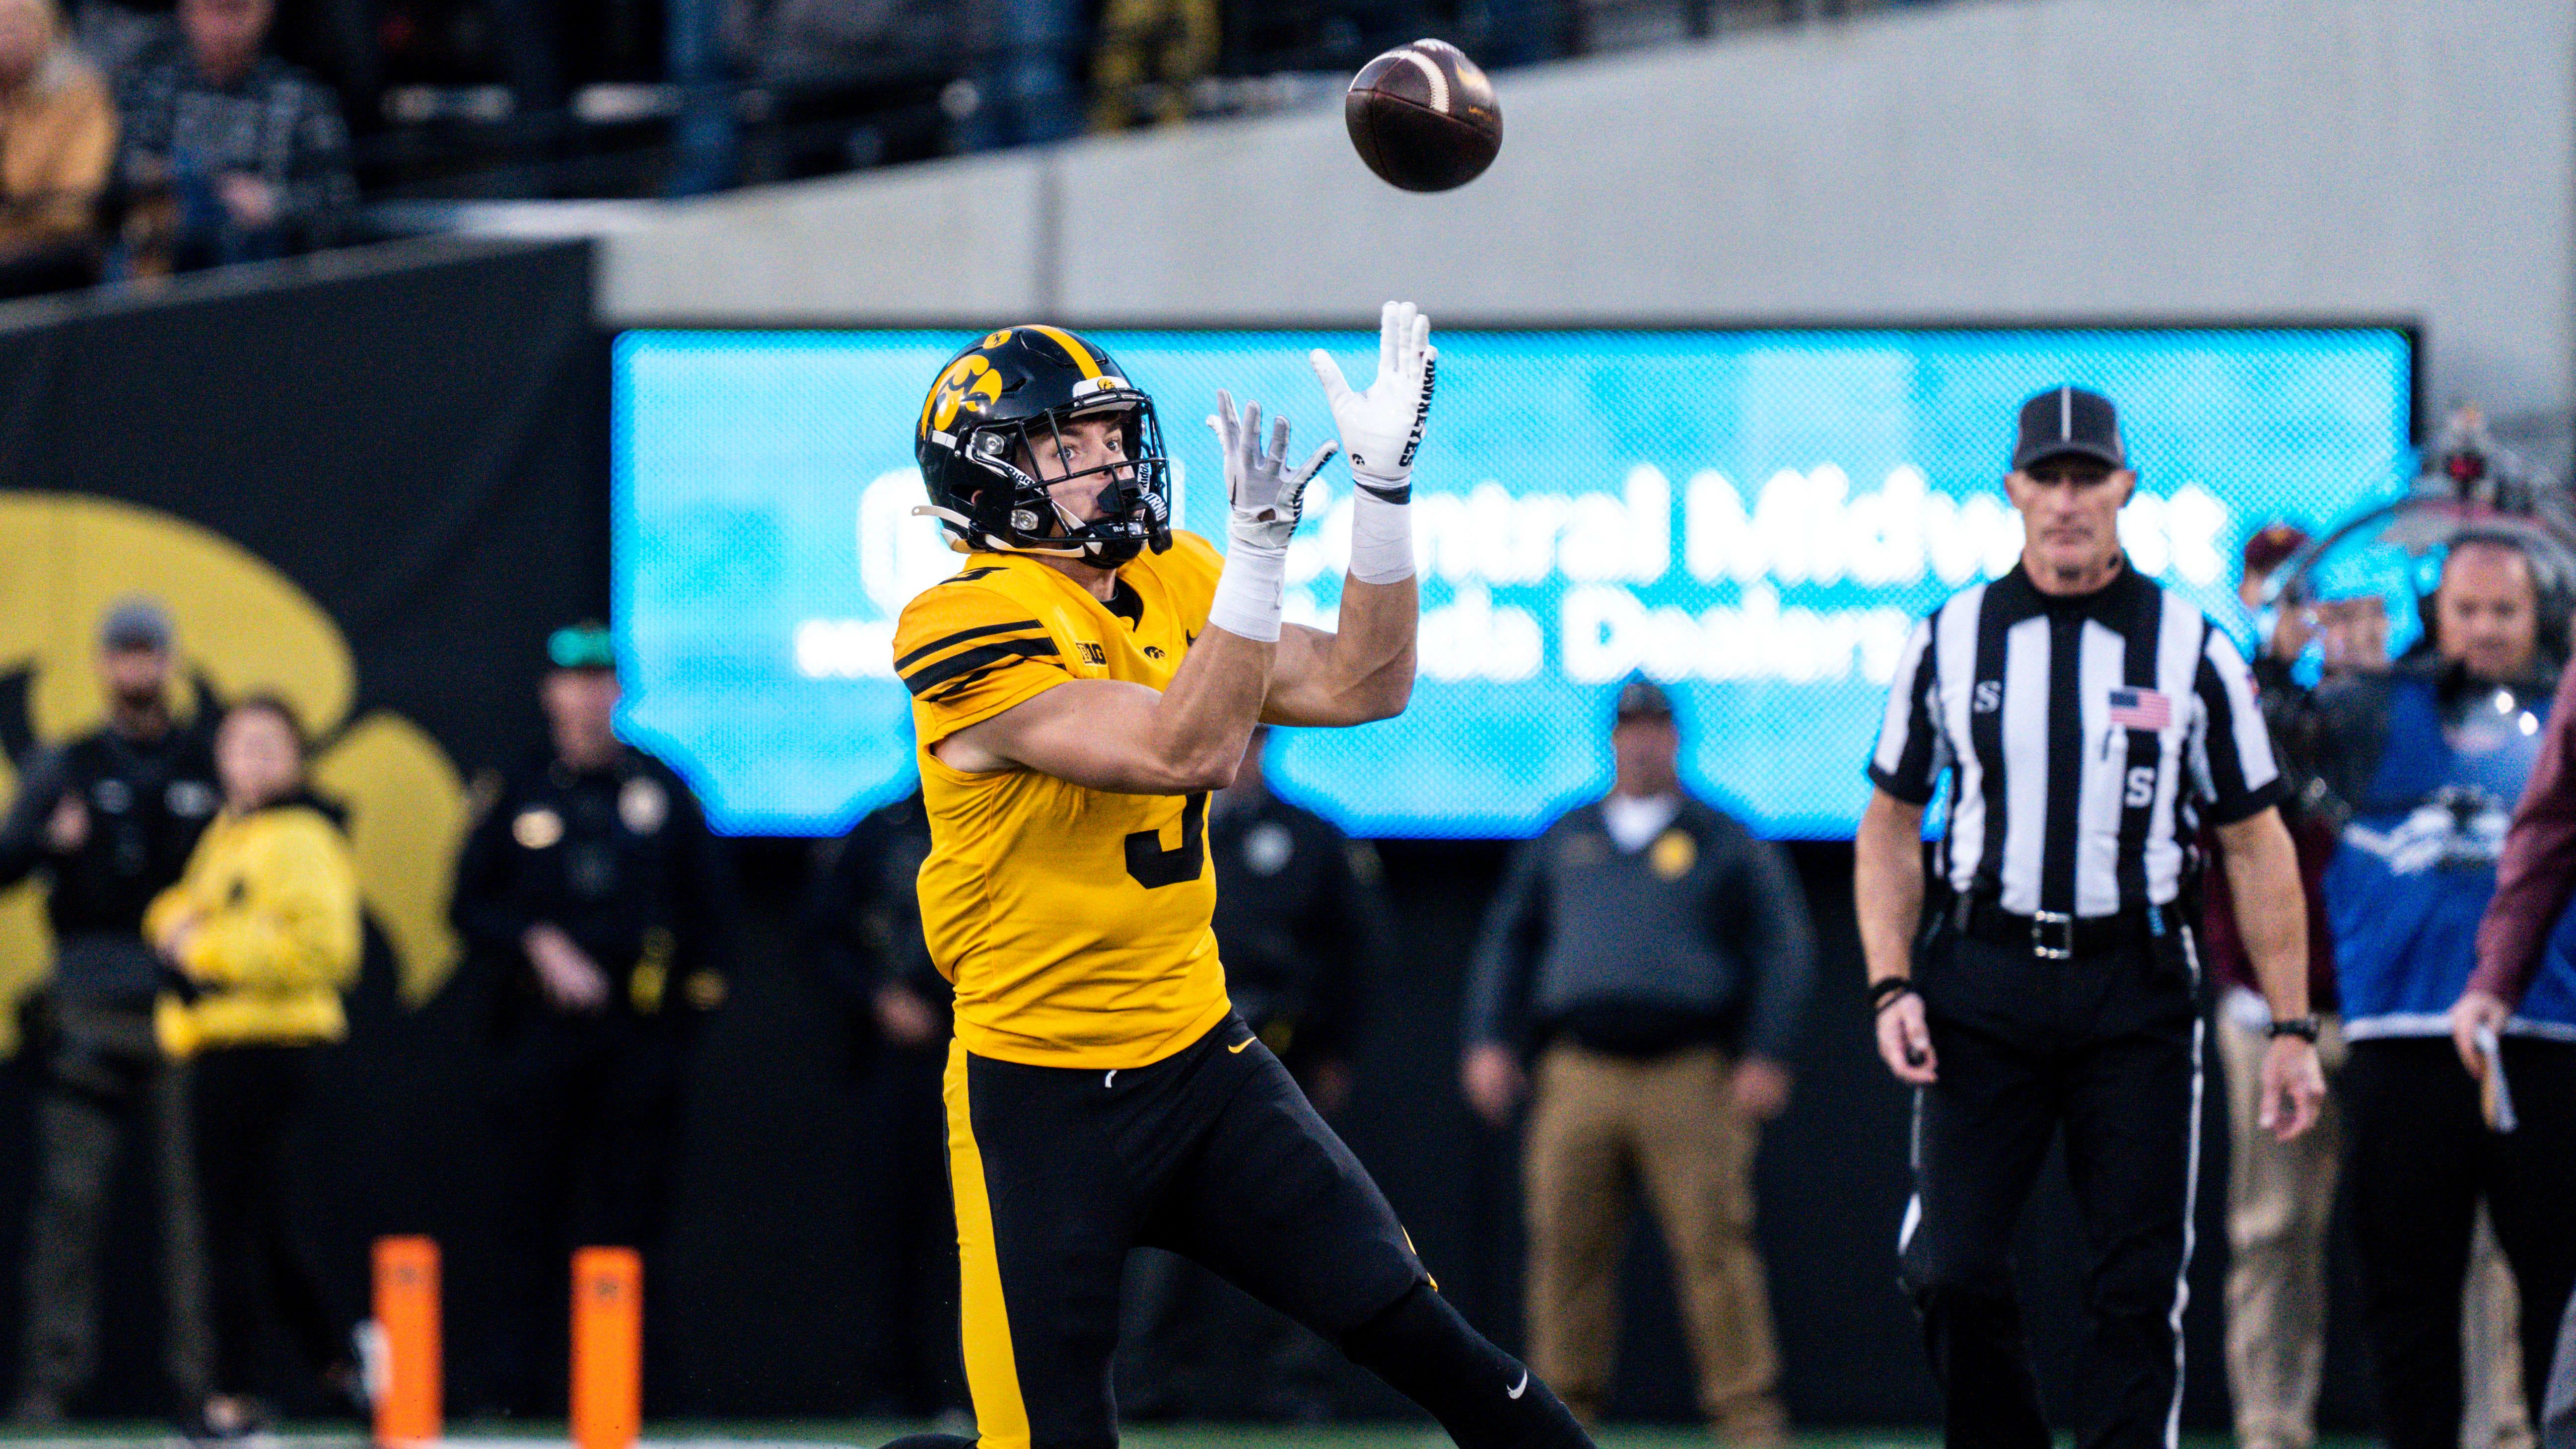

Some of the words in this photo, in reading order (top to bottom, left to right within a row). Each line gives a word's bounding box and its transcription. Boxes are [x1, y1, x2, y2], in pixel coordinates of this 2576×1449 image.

[1141, 493, 1168, 521] TRND
[1687, 463, 2228, 587] Midwst
[1974, 680, 2002, 713] S
[2125, 766, 2156, 807] S
